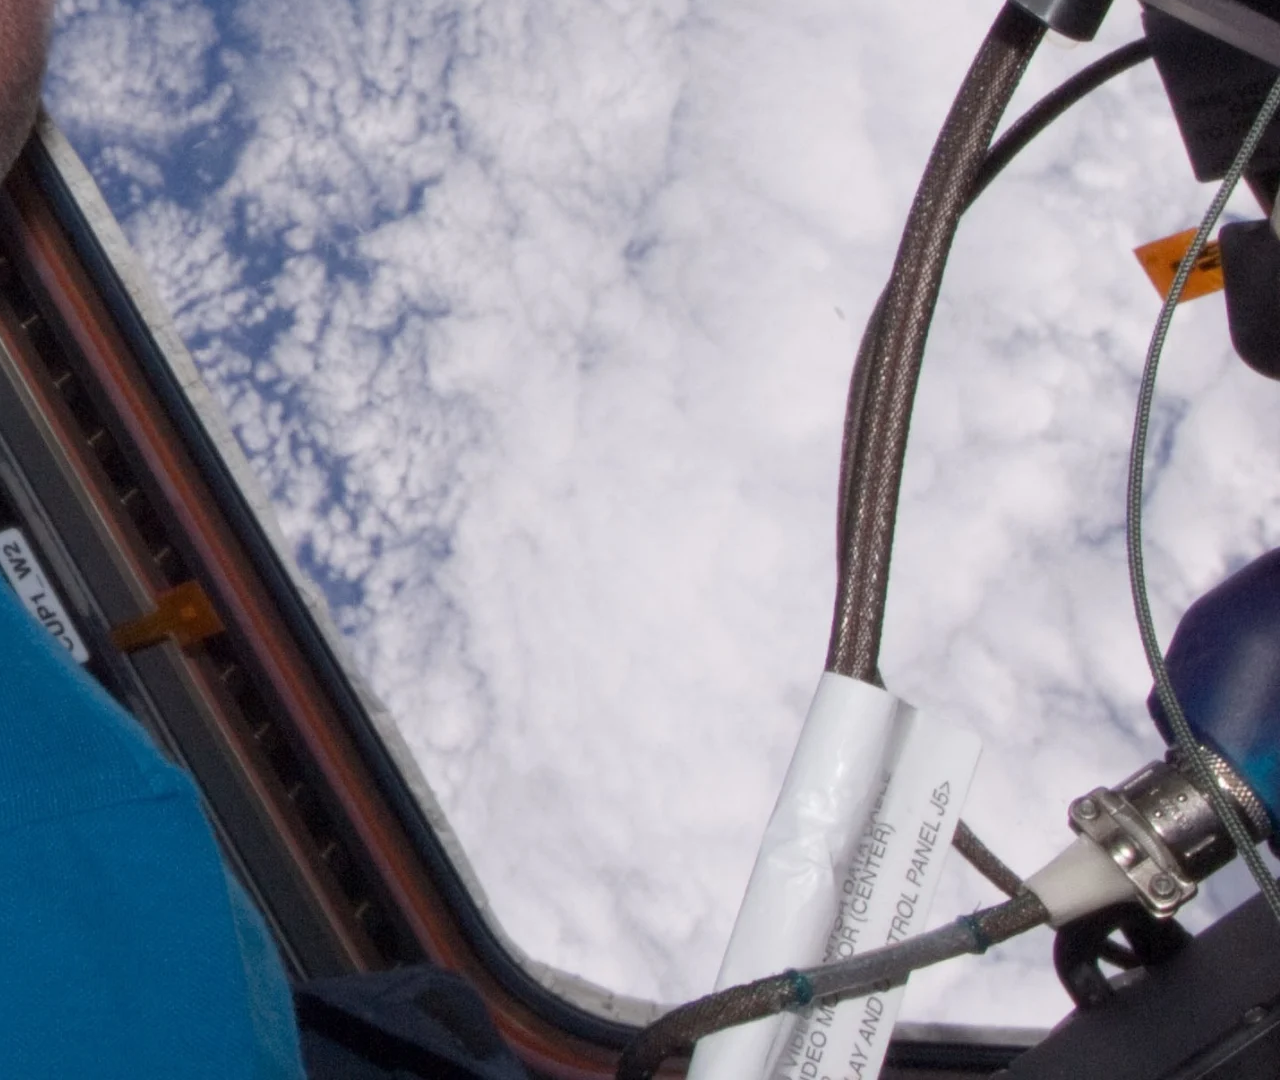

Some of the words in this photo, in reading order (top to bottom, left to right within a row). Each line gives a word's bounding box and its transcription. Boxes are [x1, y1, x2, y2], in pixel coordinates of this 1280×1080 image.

[848, 822, 897, 923] (CENTER)
[859, 996, 884, 1047] AND
[906, 821, 942, 888] PANEL
